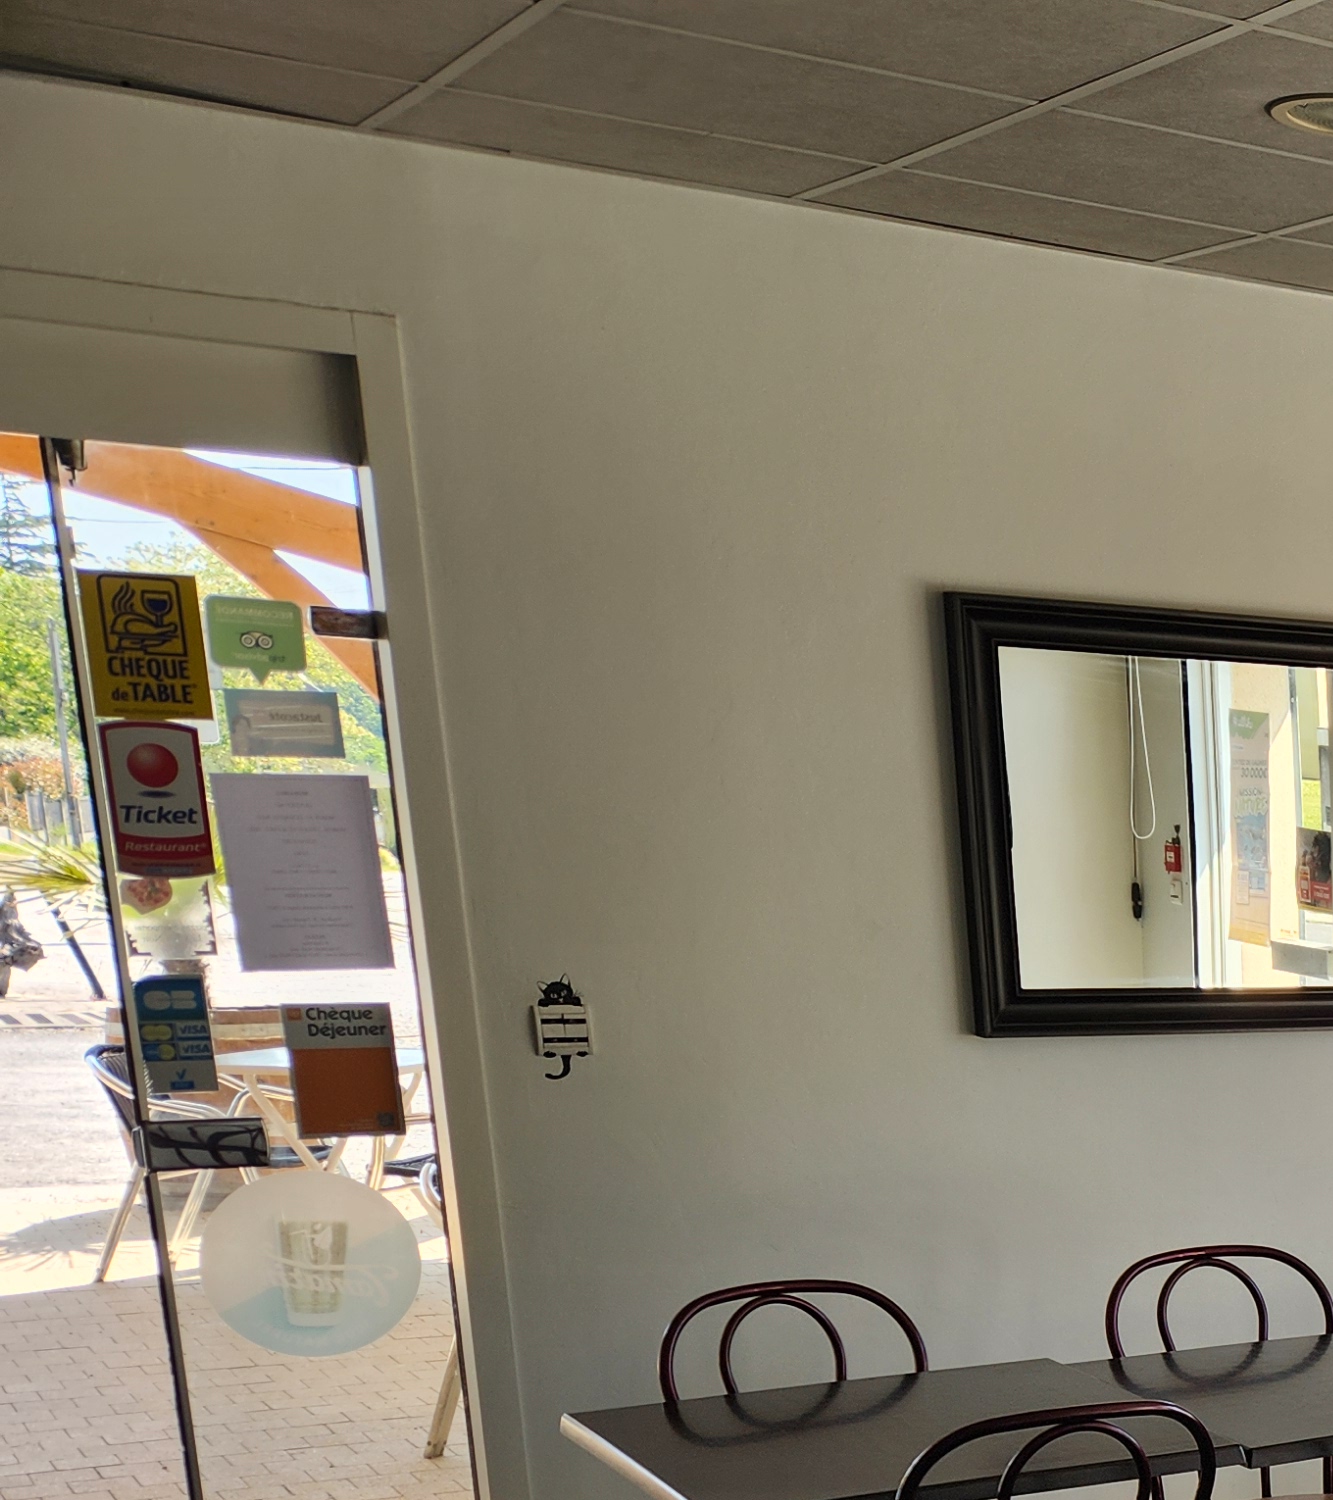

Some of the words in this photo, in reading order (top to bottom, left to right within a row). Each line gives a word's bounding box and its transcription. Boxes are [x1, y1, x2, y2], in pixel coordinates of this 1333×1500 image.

[107, 656, 190, 681] CHEQUE
[112, 687, 128, 702] de
[120, 805, 198, 824] Ticket
[305, 1006, 373, 1022] Chèque
[179, 1024, 208, 1034] VISA
[307, 1022, 387, 1039] Déjeuner
[182, 1044, 210, 1053] VISA
